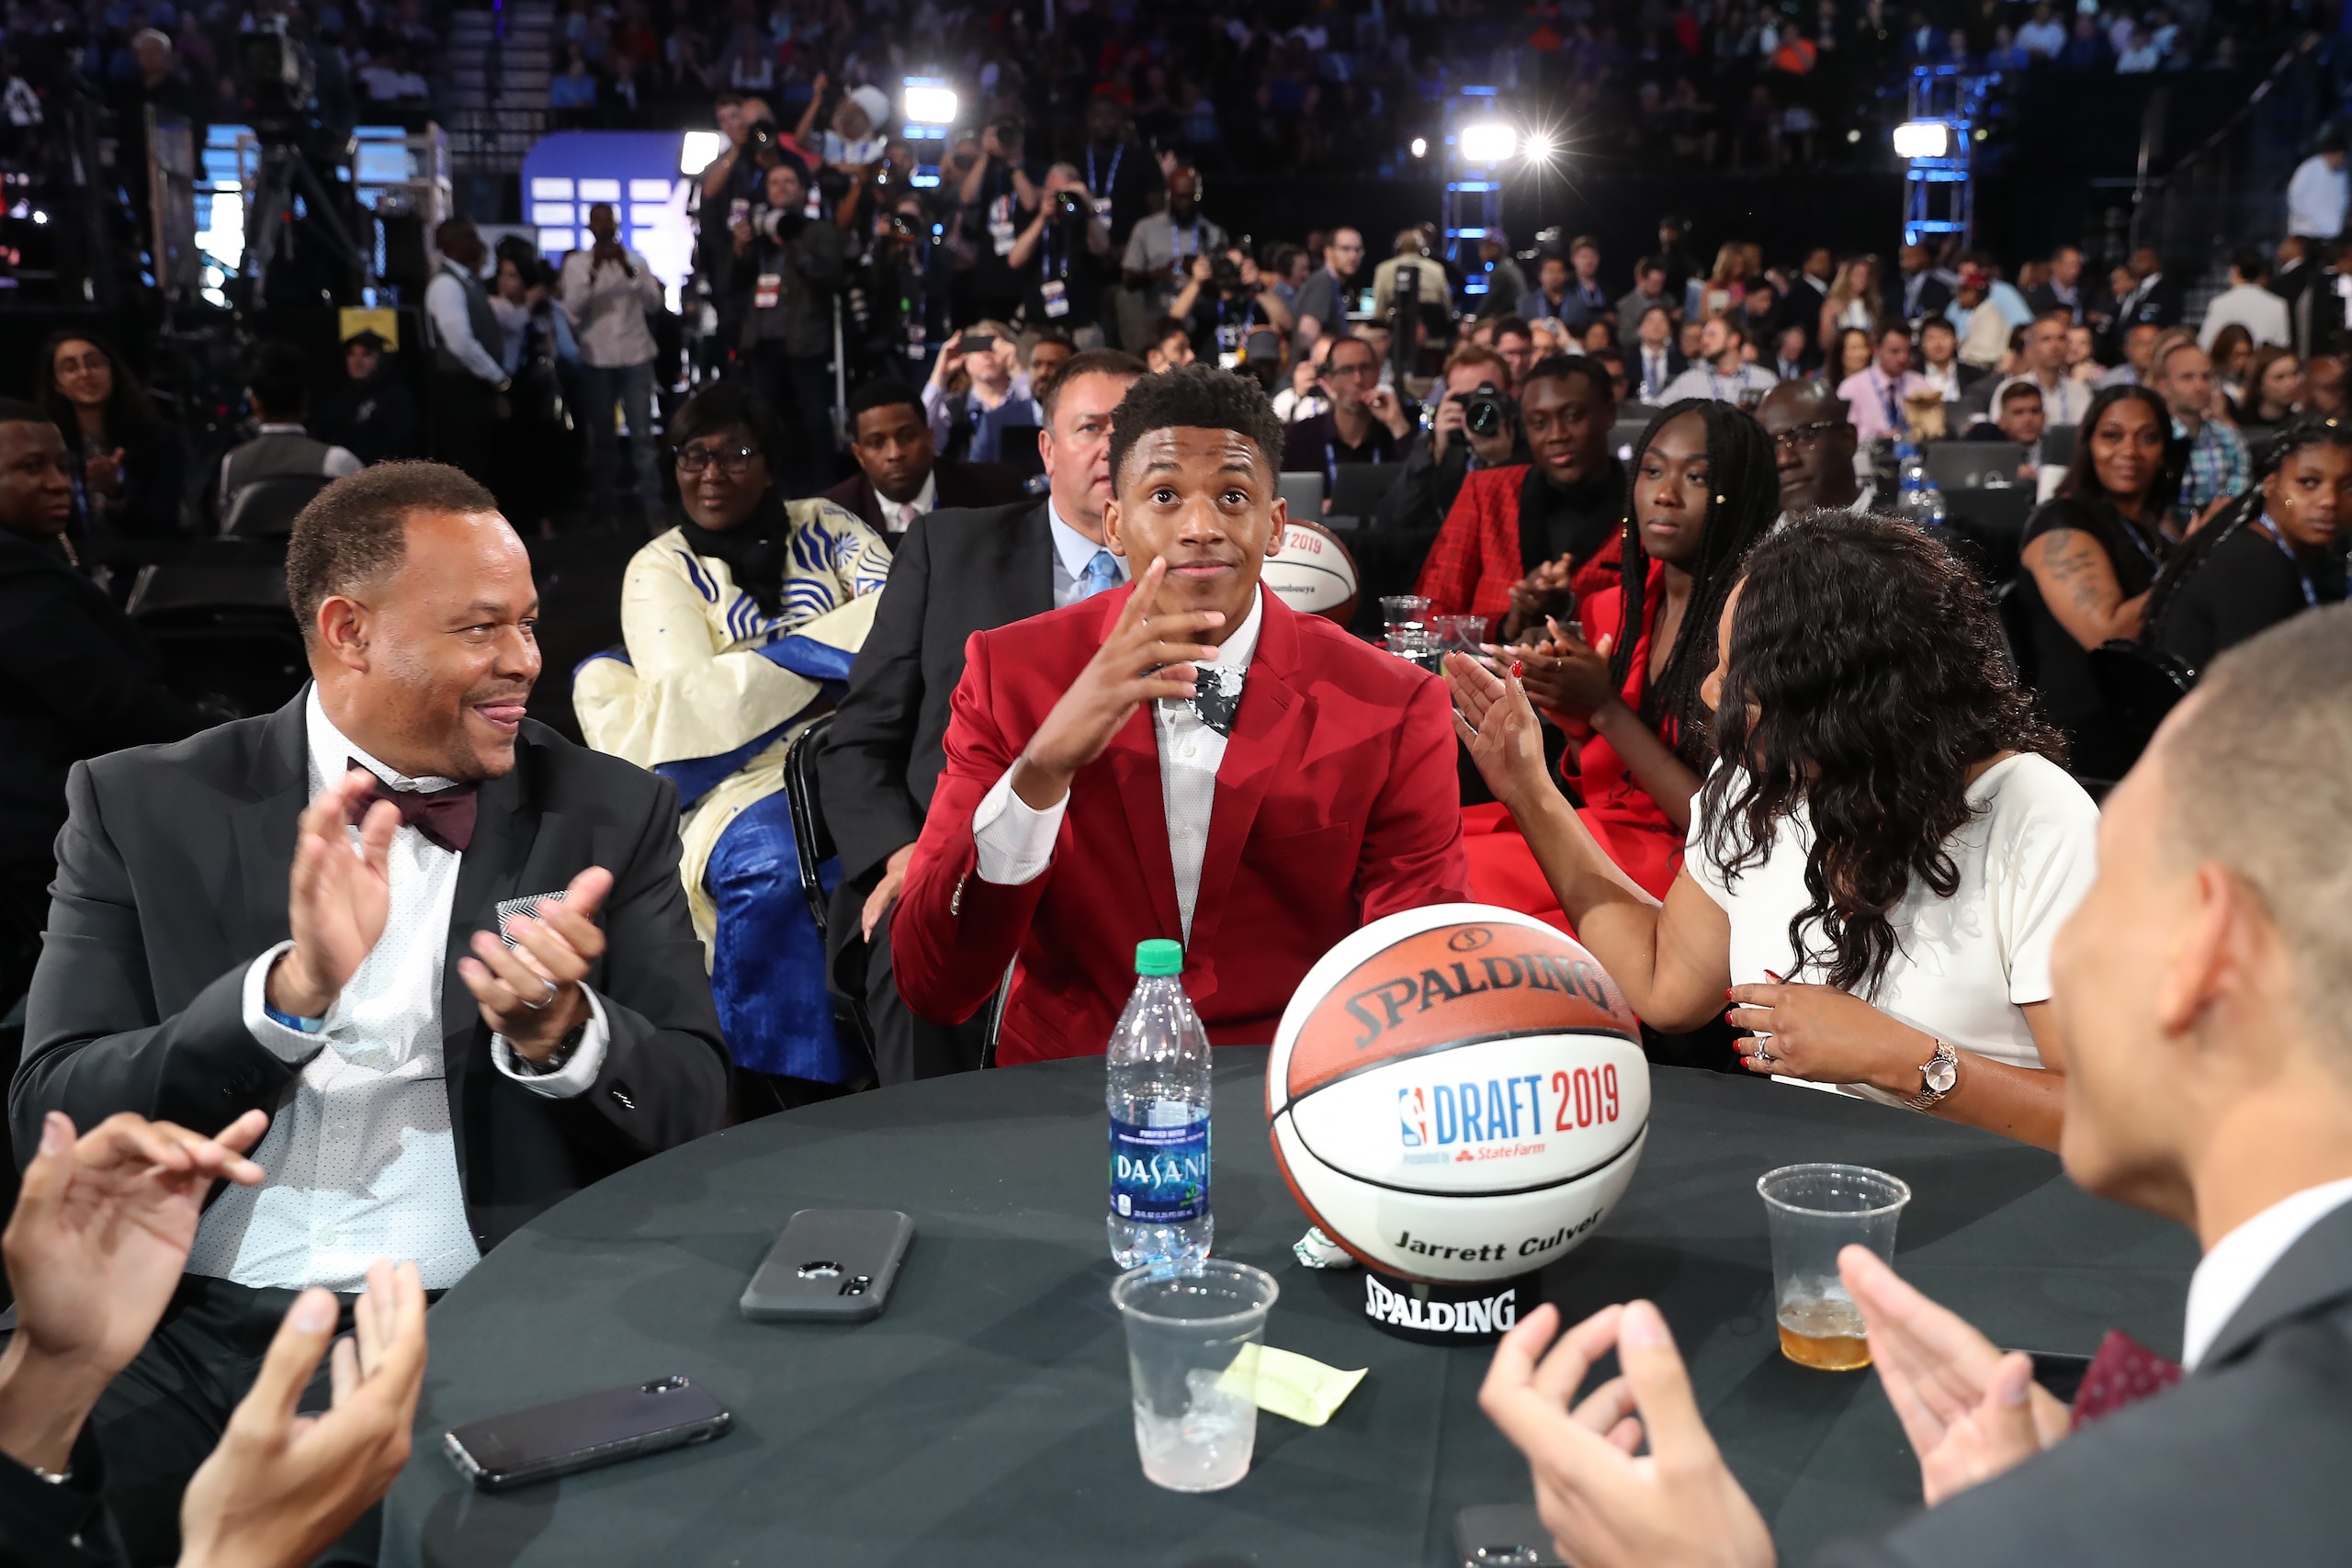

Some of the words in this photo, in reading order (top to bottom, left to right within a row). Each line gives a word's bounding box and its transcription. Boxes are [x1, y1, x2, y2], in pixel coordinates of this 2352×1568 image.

[1291, 533, 1322, 554] 2019
[1267, 582, 1316, 595] oumbouya
[1345, 954, 1610, 1049] SPALDING
[1433, 1074, 1543, 1145] DRAFT
[1552, 1062, 1619, 1132] 2019
[1117, 1153, 1205, 1189] DASANI
[1395, 1230, 1507, 1261] Jarrett
[1519, 1207, 1603, 1257] Culver
[1365, 1273, 1516, 1332] SPALDING
